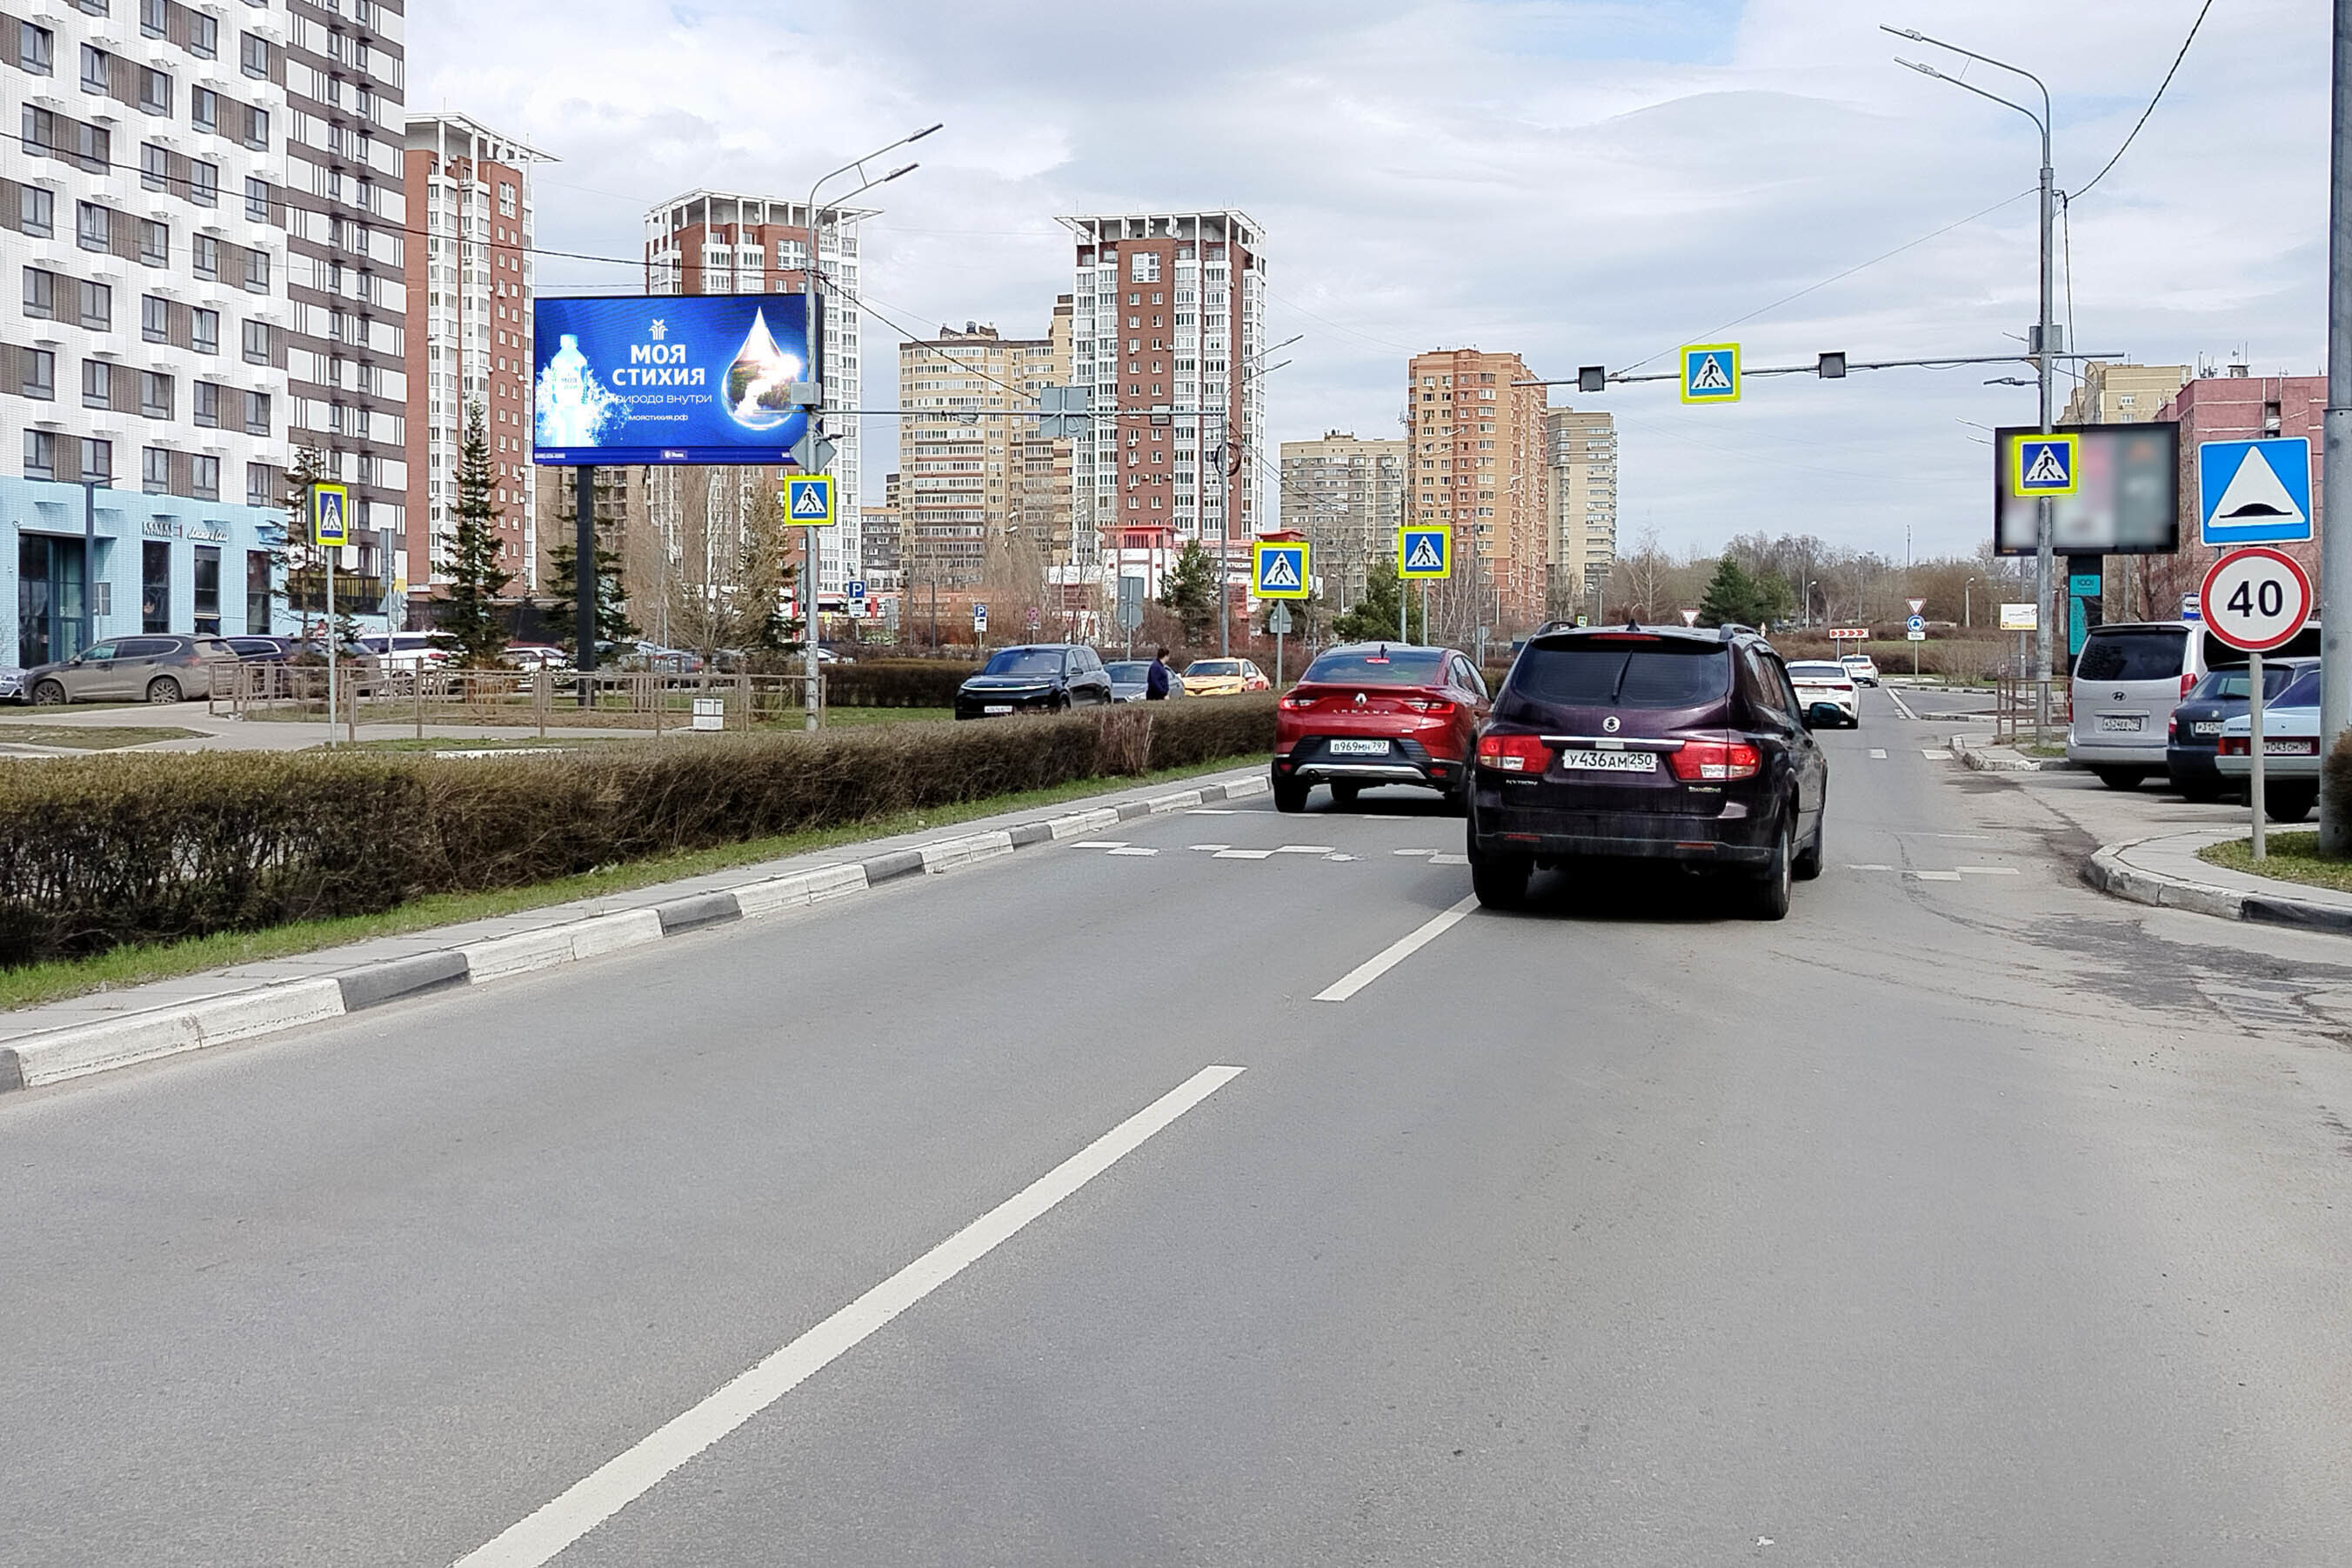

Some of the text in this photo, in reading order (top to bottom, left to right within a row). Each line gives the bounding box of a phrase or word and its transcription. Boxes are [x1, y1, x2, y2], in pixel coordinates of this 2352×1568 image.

[631, 344, 686, 364] МОЯ
[611, 368, 705, 386] СТИХИЯ
[666, 394, 712, 405] внутри
[852, 583, 863, 597] P
[2227, 579, 2283, 617] 40
[1629, 753, 1653, 766] 250
